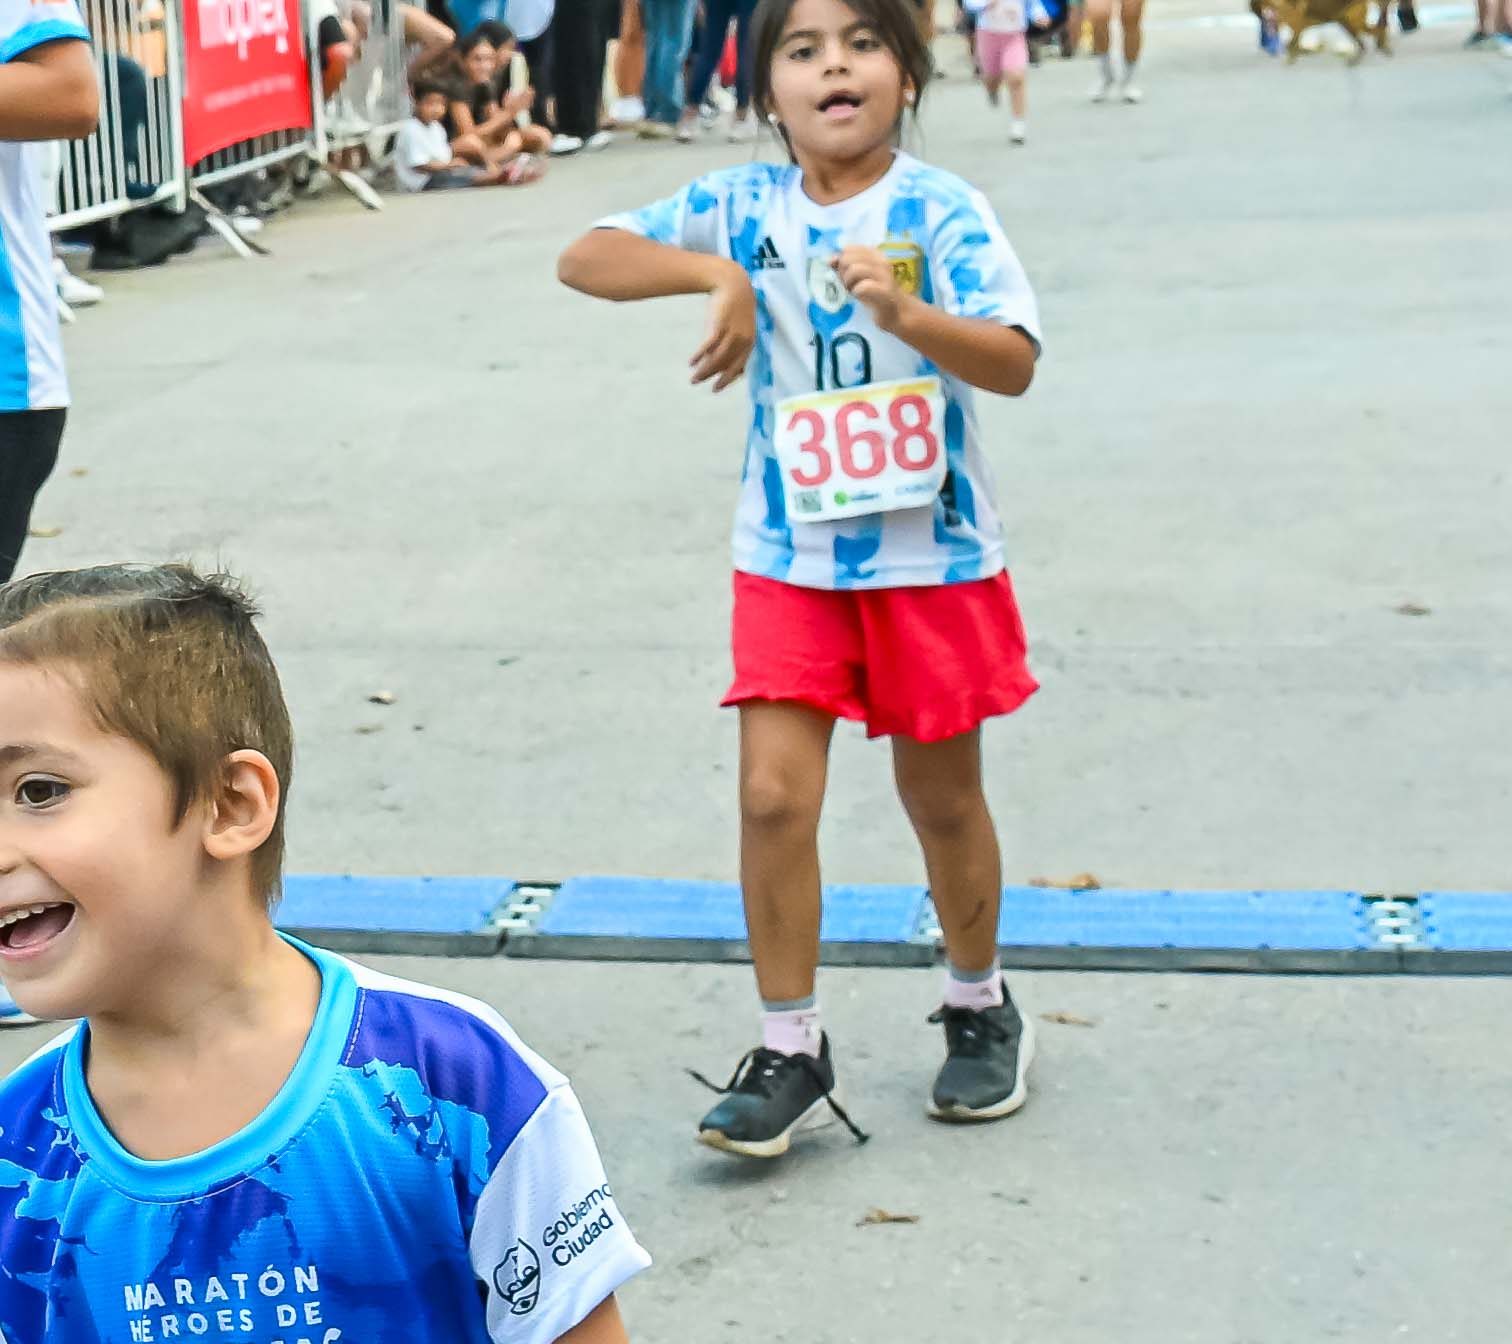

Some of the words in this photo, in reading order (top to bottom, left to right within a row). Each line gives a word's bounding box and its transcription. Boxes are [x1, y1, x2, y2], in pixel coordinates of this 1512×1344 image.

[786, 392, 939, 488] 368
[551, 1208, 614, 1267] Ciudad
[124, 1263, 320, 1312] MARATÓN
[129, 1309, 255, 1343] HÉROES
[276, 1301, 323, 1327] DE
